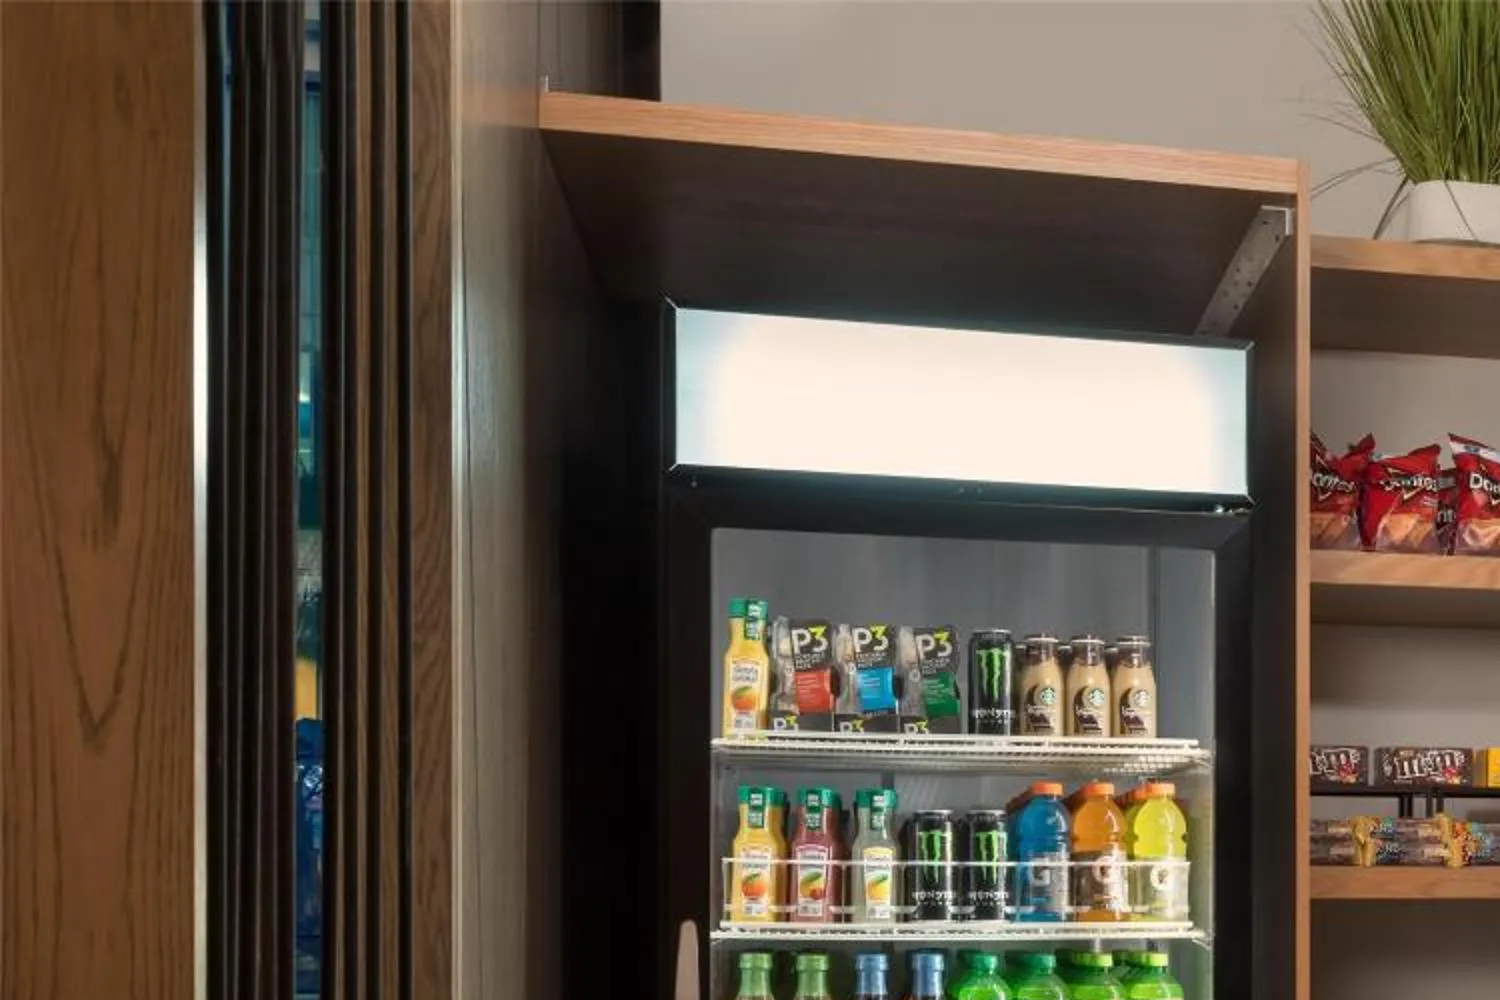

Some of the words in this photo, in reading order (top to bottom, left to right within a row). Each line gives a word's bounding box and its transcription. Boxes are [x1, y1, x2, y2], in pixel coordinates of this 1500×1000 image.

[791, 625, 829, 655] P3
[852, 625, 890, 653] P3
[915, 631, 953, 660] P3
